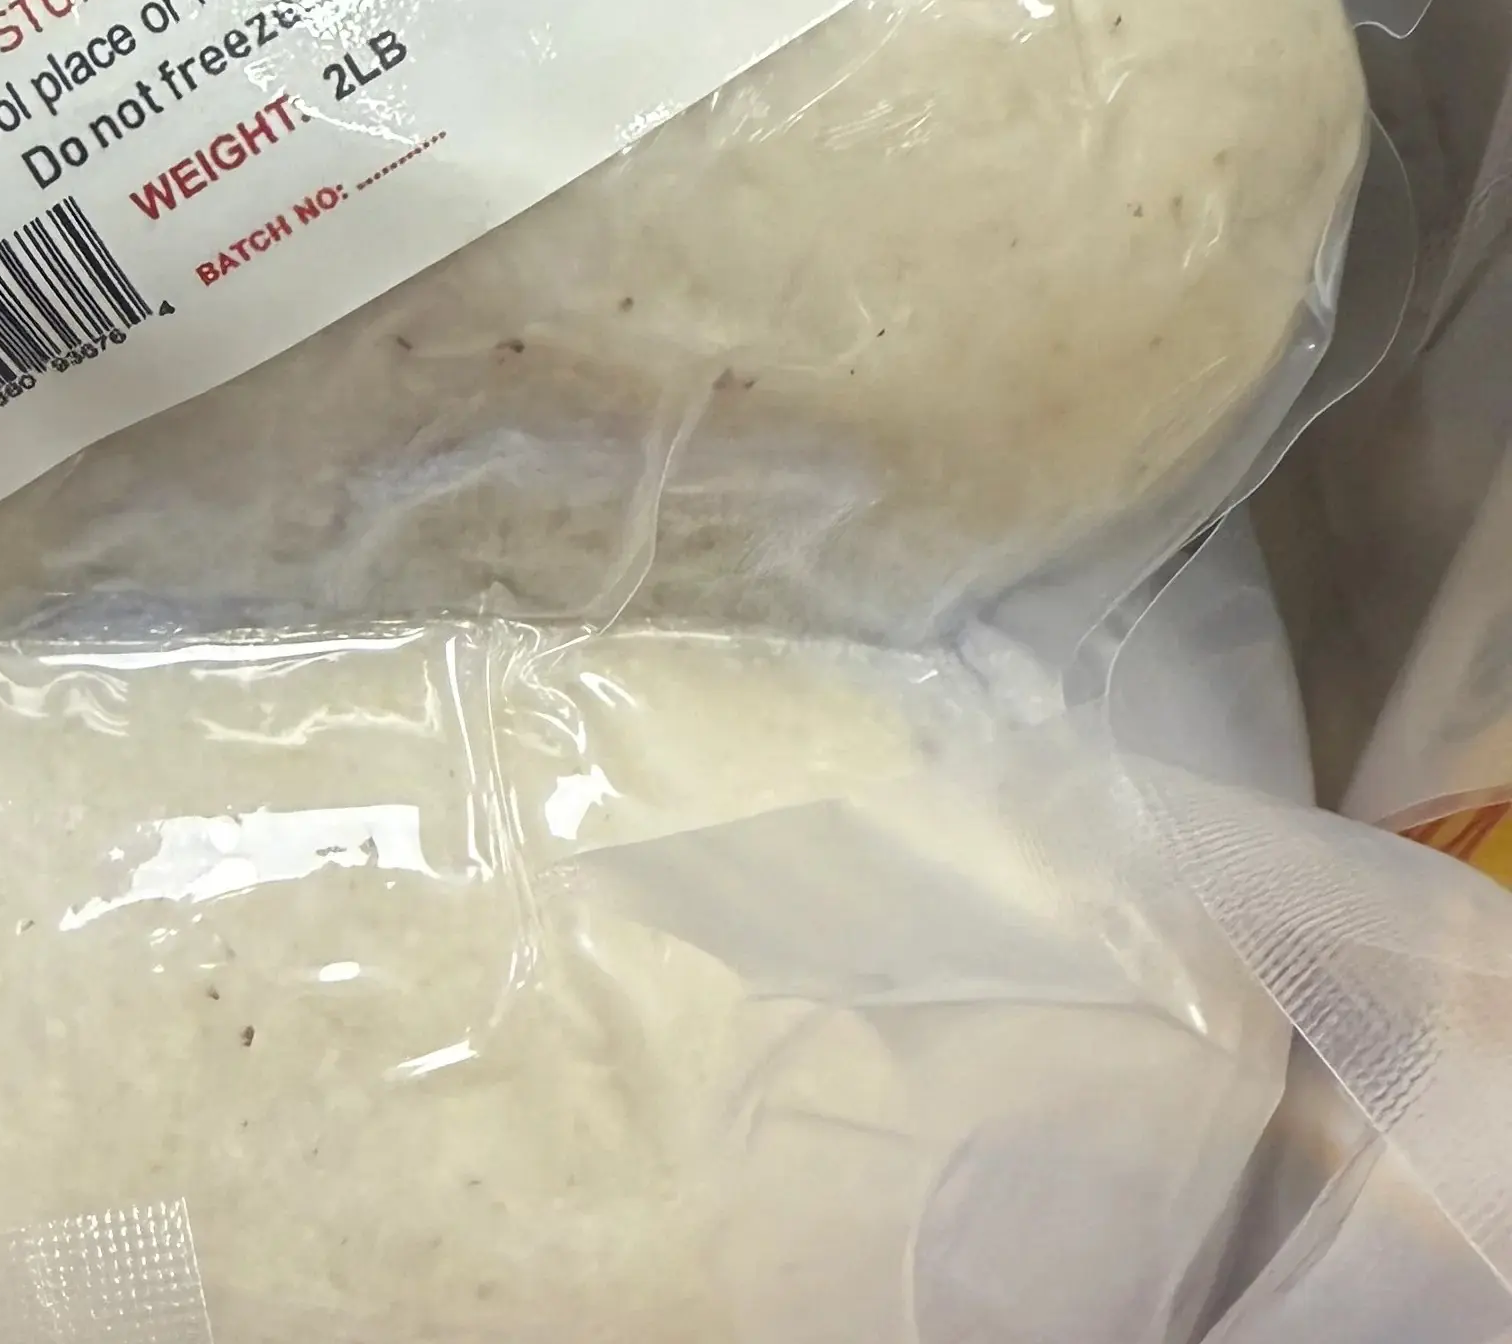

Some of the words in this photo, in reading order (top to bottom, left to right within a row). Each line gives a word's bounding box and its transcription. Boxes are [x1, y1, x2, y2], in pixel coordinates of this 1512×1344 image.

[30, 24, 136, 116] place
[323, 29, 407, 101] 2LB
[21, 136, 89, 189] Do
[89, 80, 164, 148] not
[195, 215, 293, 286] BATCH
[293, 184, 349, 225] NO:
